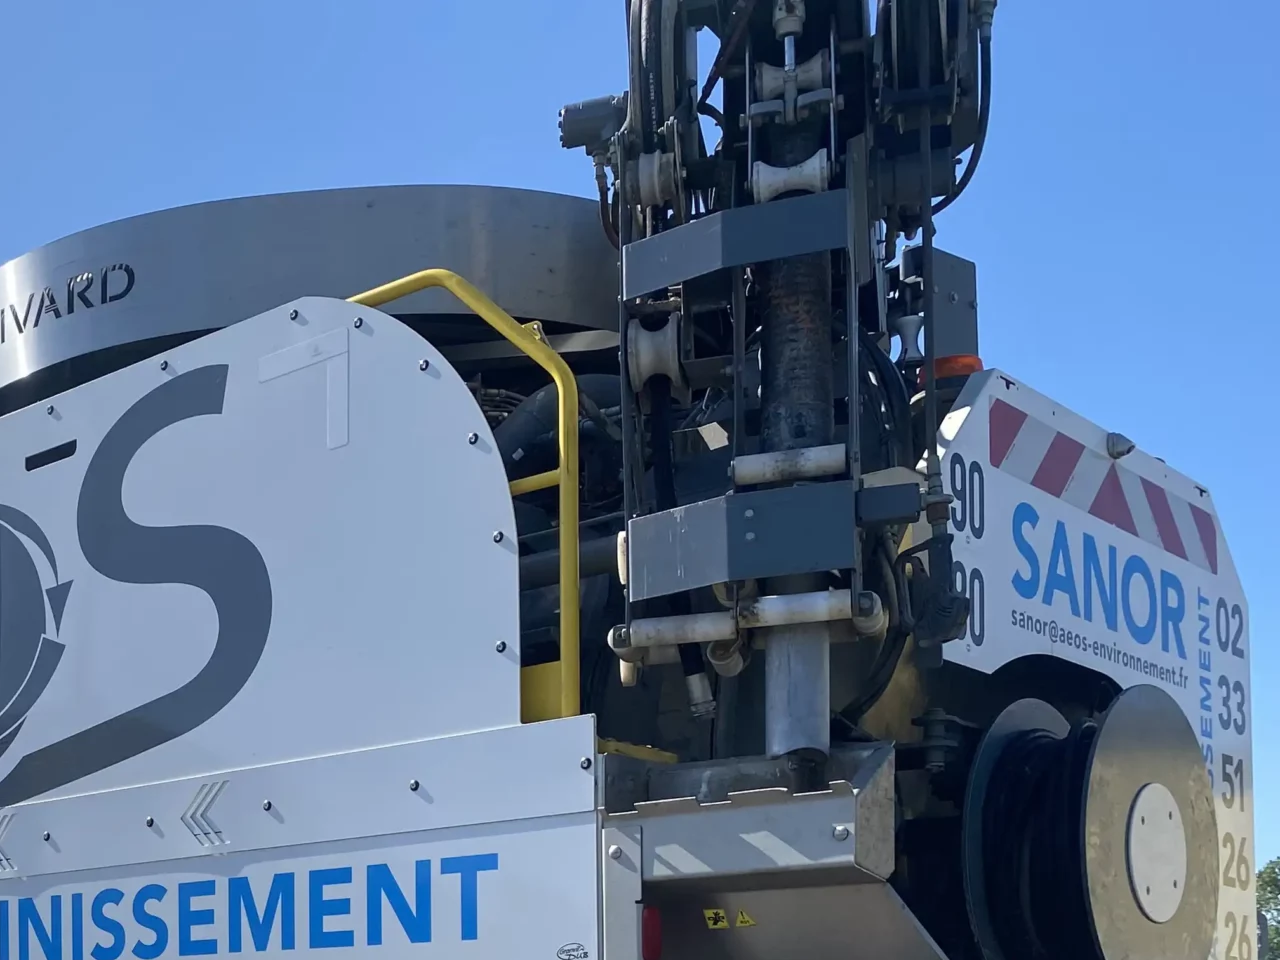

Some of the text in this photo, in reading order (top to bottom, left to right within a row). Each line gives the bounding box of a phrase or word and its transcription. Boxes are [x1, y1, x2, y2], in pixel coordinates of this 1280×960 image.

[950, 453, 985, 539] 90
[1011, 502, 1188, 660] SANOR
[1011, 608, 1189, 690] sanor@aeos-environnement.fr
[1216, 597, 1245, 660] 02
[1218, 674, 1246, 736] 33
[1222, 753, 1245, 812] 51
[1222, 832, 1250, 891] 26
